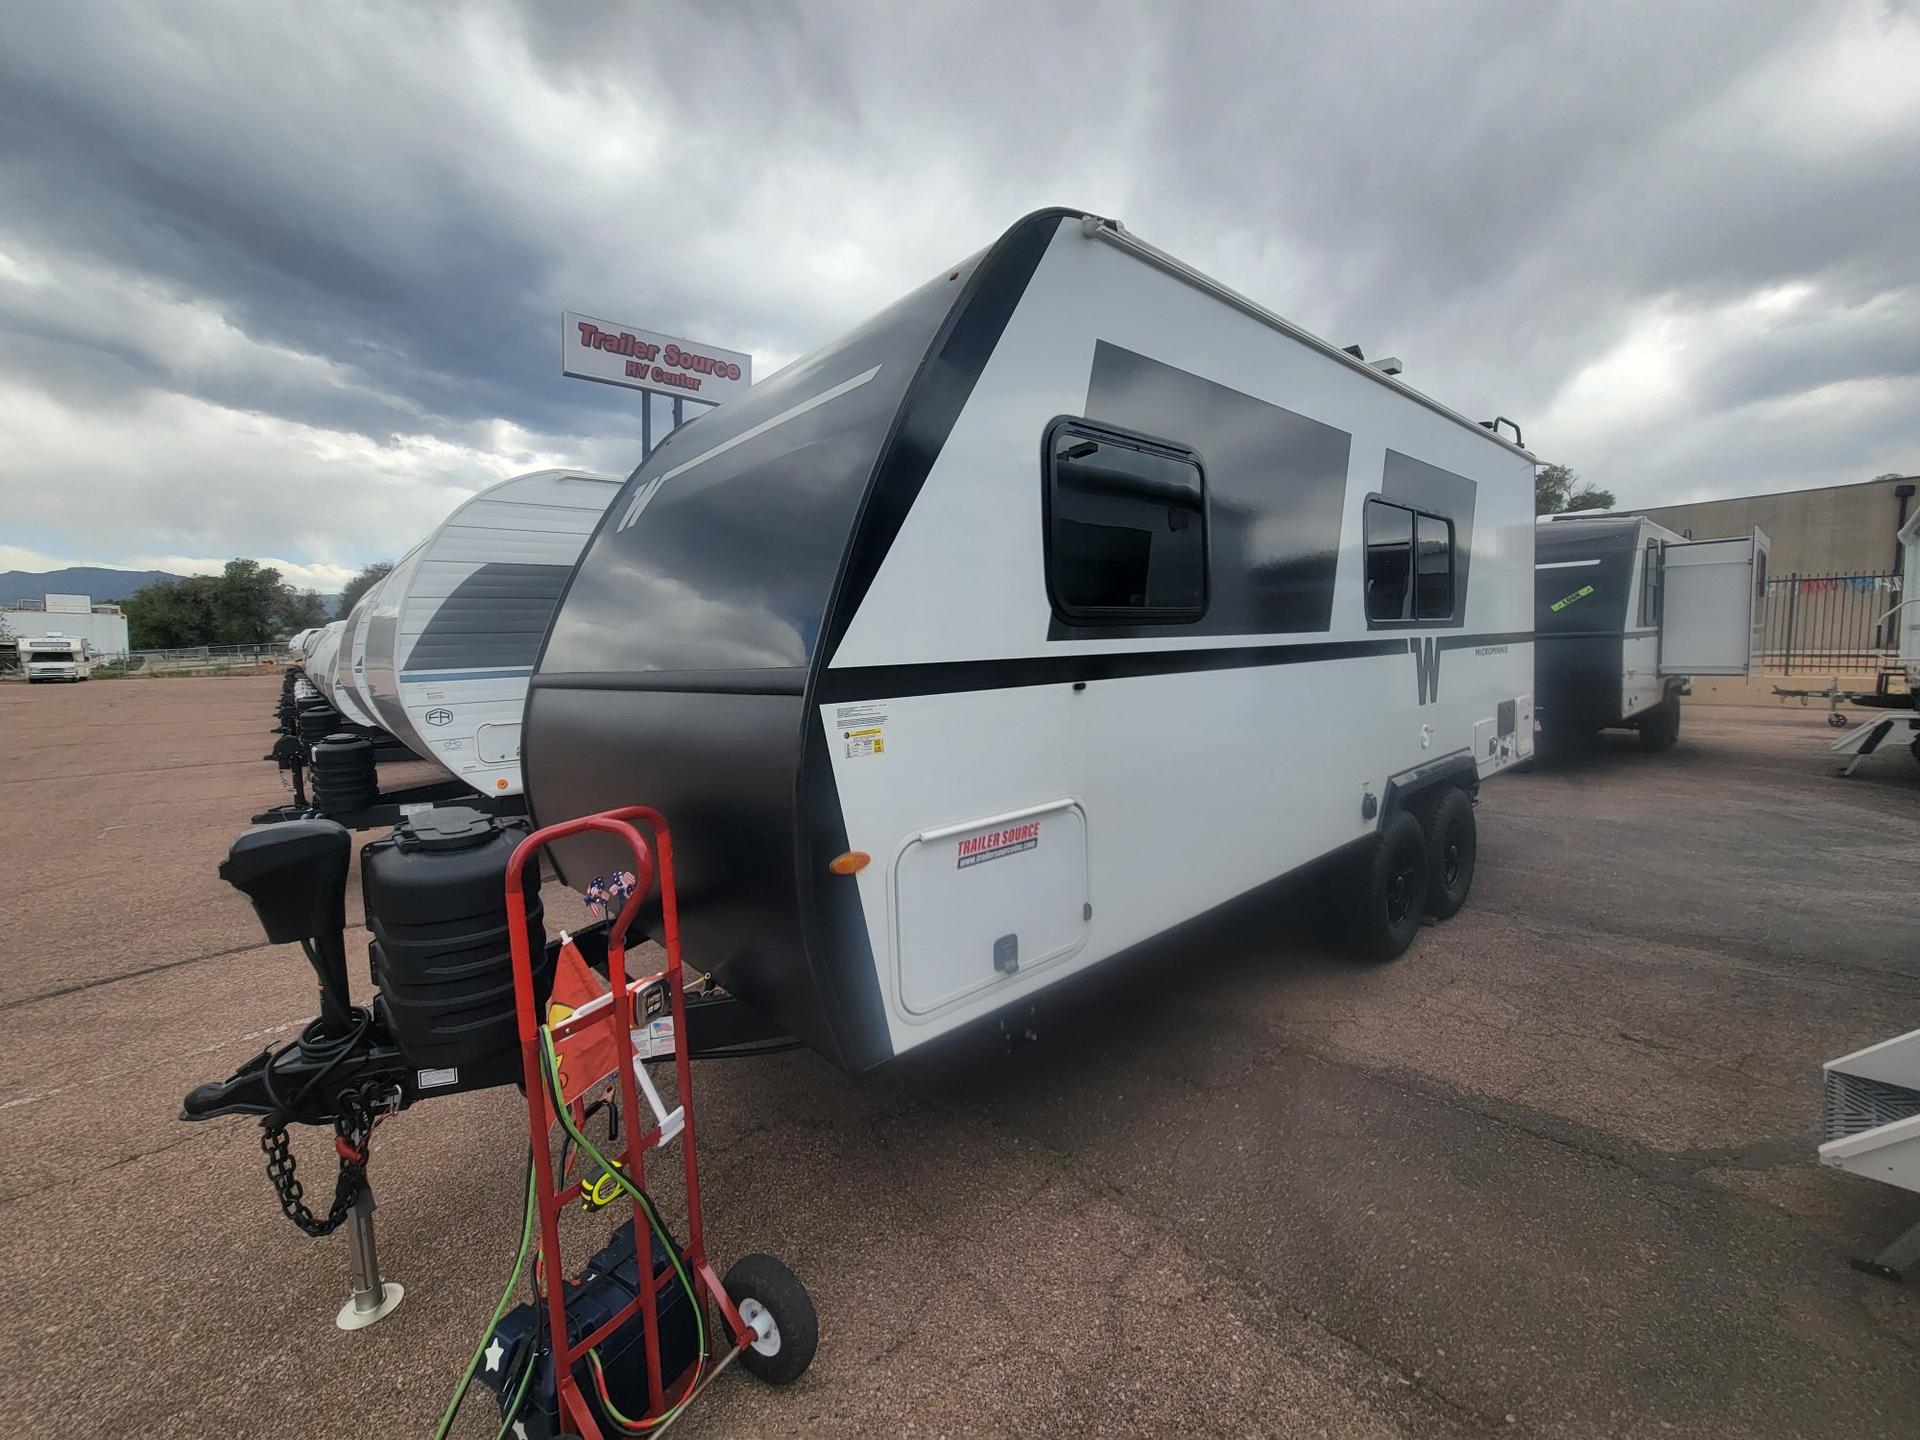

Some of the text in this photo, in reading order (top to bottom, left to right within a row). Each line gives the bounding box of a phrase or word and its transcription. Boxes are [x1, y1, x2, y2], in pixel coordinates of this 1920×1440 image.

[578, 322, 741, 380] Trailer Source
[625, 360, 701, 391] RV Center
[958, 832, 1000, 856] TRAILER
[1002, 822, 1040, 844] SOURCE
